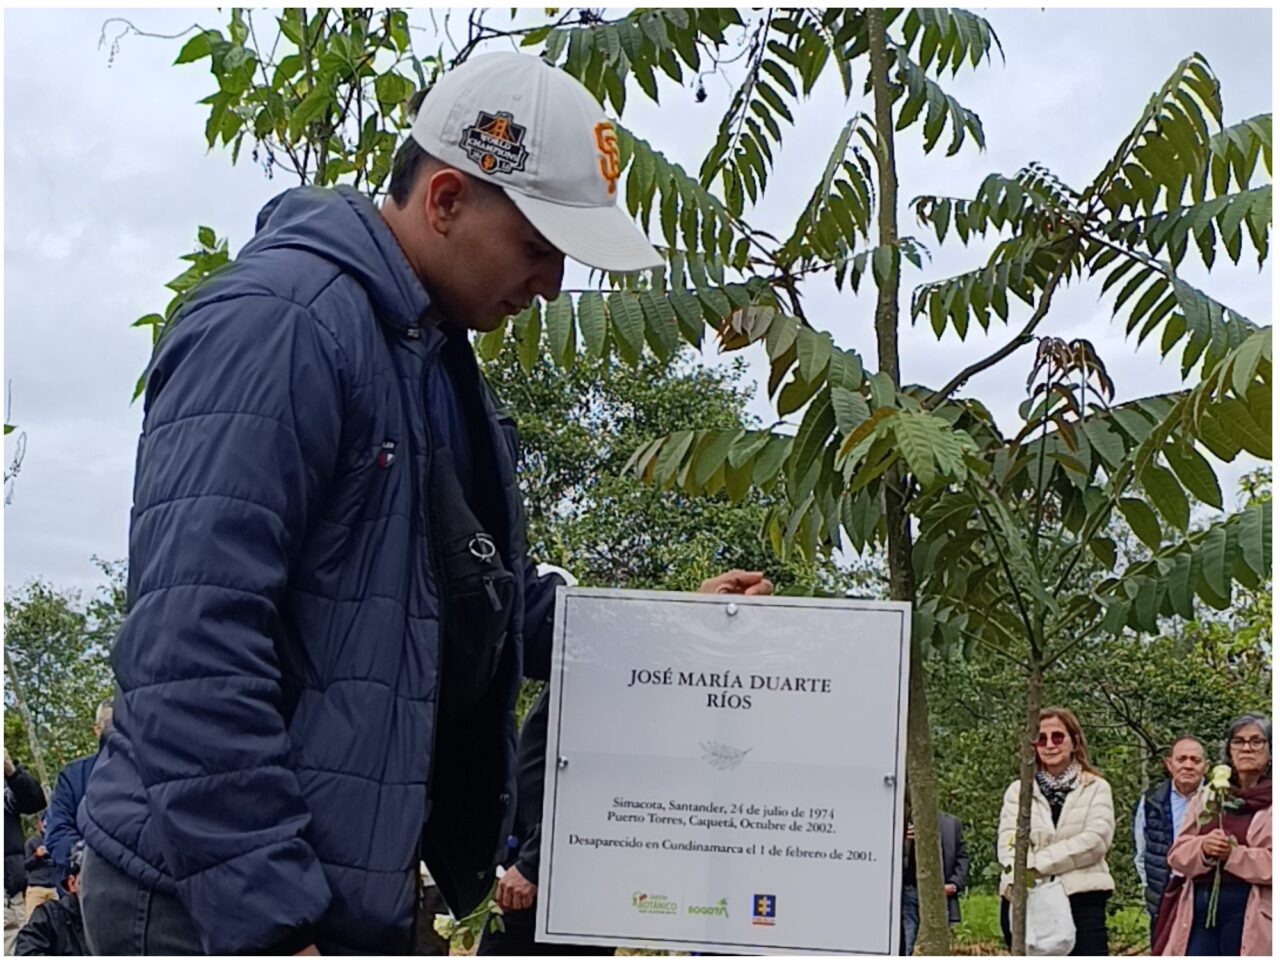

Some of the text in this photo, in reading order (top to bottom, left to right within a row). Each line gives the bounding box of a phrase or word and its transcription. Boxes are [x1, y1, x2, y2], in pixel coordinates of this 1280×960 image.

[628, 667, 832, 693] JOSÉ MARÍA DUARTE
[706, 691, 753, 709] RÍOS
[612, 797, 835, 819] Simacota, Santander, 24 de julio de 1974
[607, 811, 836, 834] Puerto Torres, Caquetá, Octubre de 2002.
[569, 834, 877, 862] Desaparecido en Cundinamarca el 1 de febrero de 2001.
